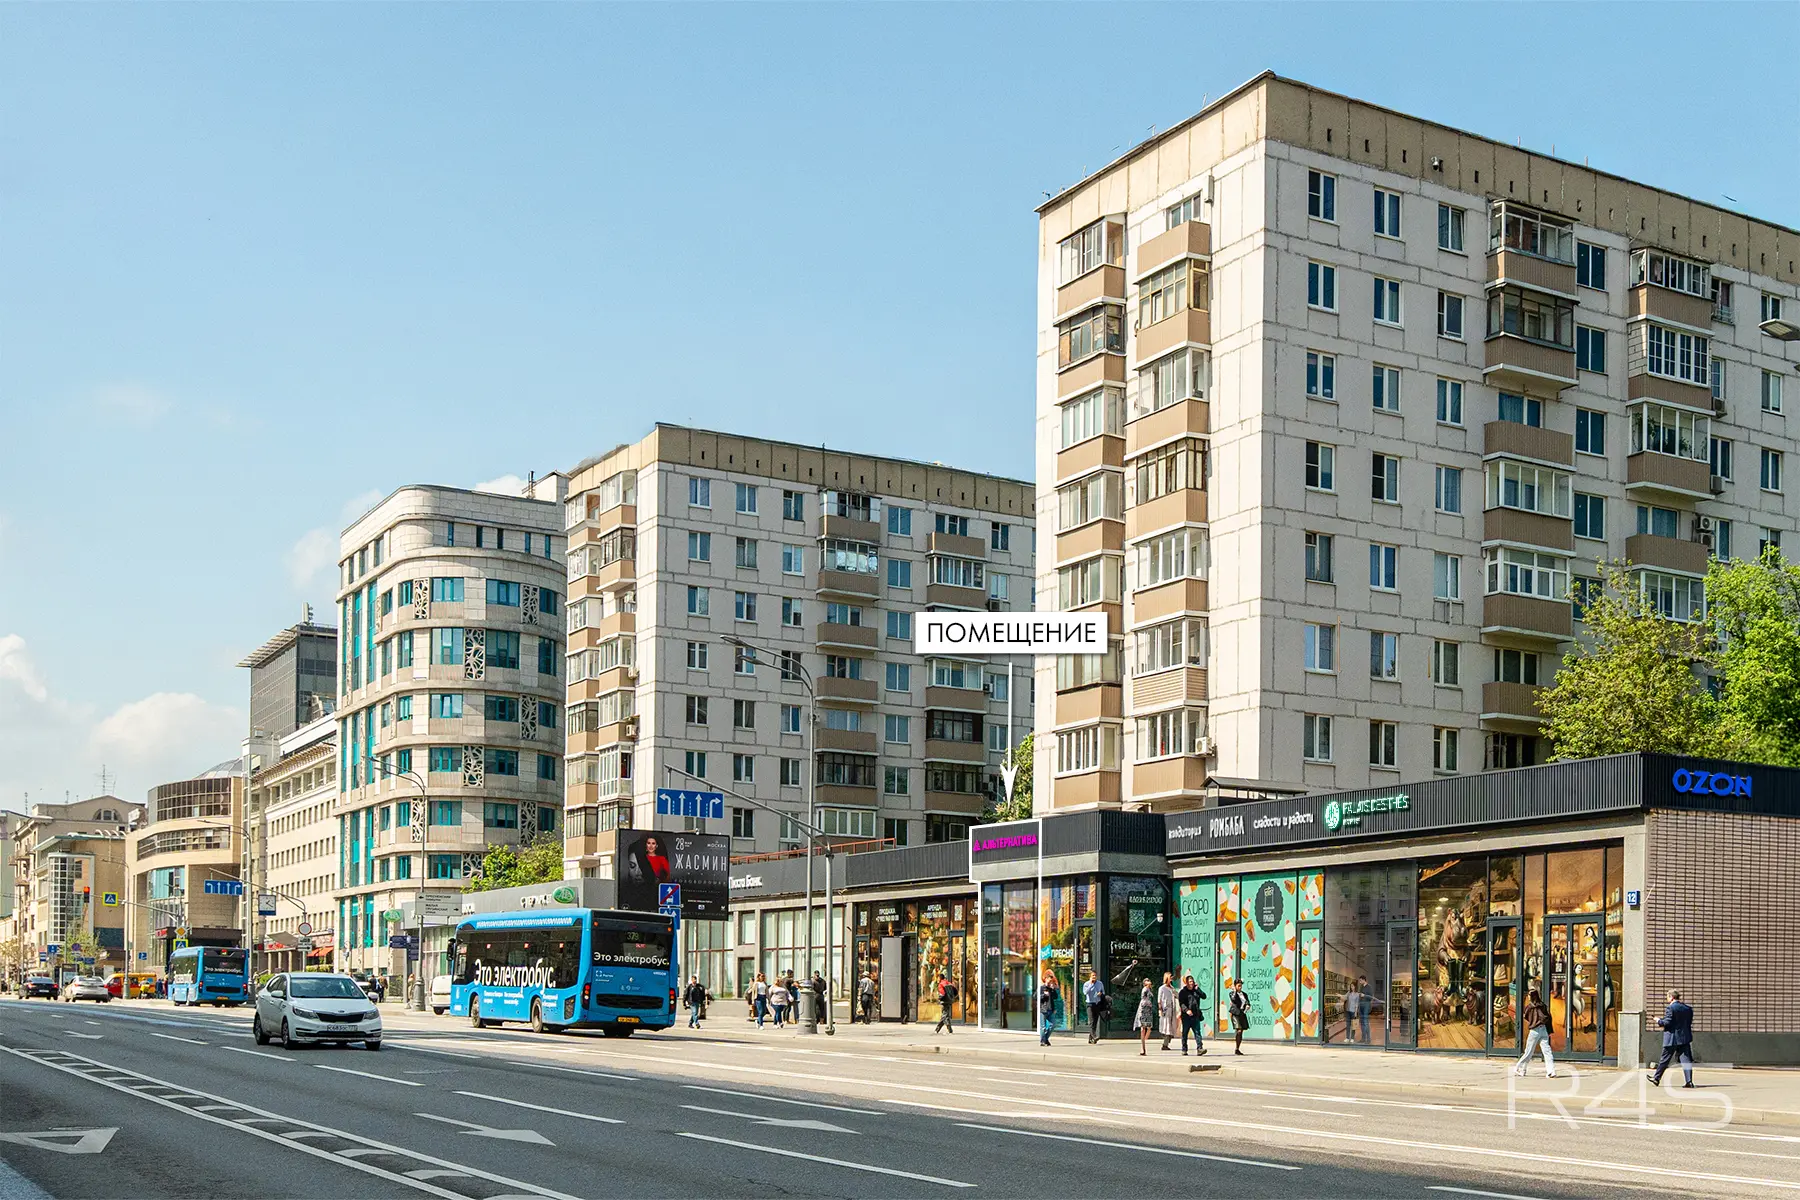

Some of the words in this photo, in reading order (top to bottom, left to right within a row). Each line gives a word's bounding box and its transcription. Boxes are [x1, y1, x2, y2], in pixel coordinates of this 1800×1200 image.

[1672, 768, 1752, 798] OZON
[1209, 815, 1245, 839] РОМБАБА
[1253, 815, 1281, 829] сладости
[1282, 816, 1288, 826] и
[1288, 811, 1314, 830] радости
[675, 837, 685, 851] 28
[982, 834, 1038, 851] АЛЬТЕРНАТИВА
[674, 853, 727, 872] ЖАСМИН
[1628, 893, 1636, 903] 12
[1182, 898, 1210, 917] СКОРО
[593, 952, 611, 961] Это
[613, 954, 670, 967] электробус.
[1184, 946, 1211, 958] РАДОСТИ
[473, 958, 492, 985] Это
[493, 957, 557, 995] электробус.
[1247, 968, 1273, 978] ЗАВТРАКИ
[1246, 980, 1273, 990] СЭНДВИЧИ
